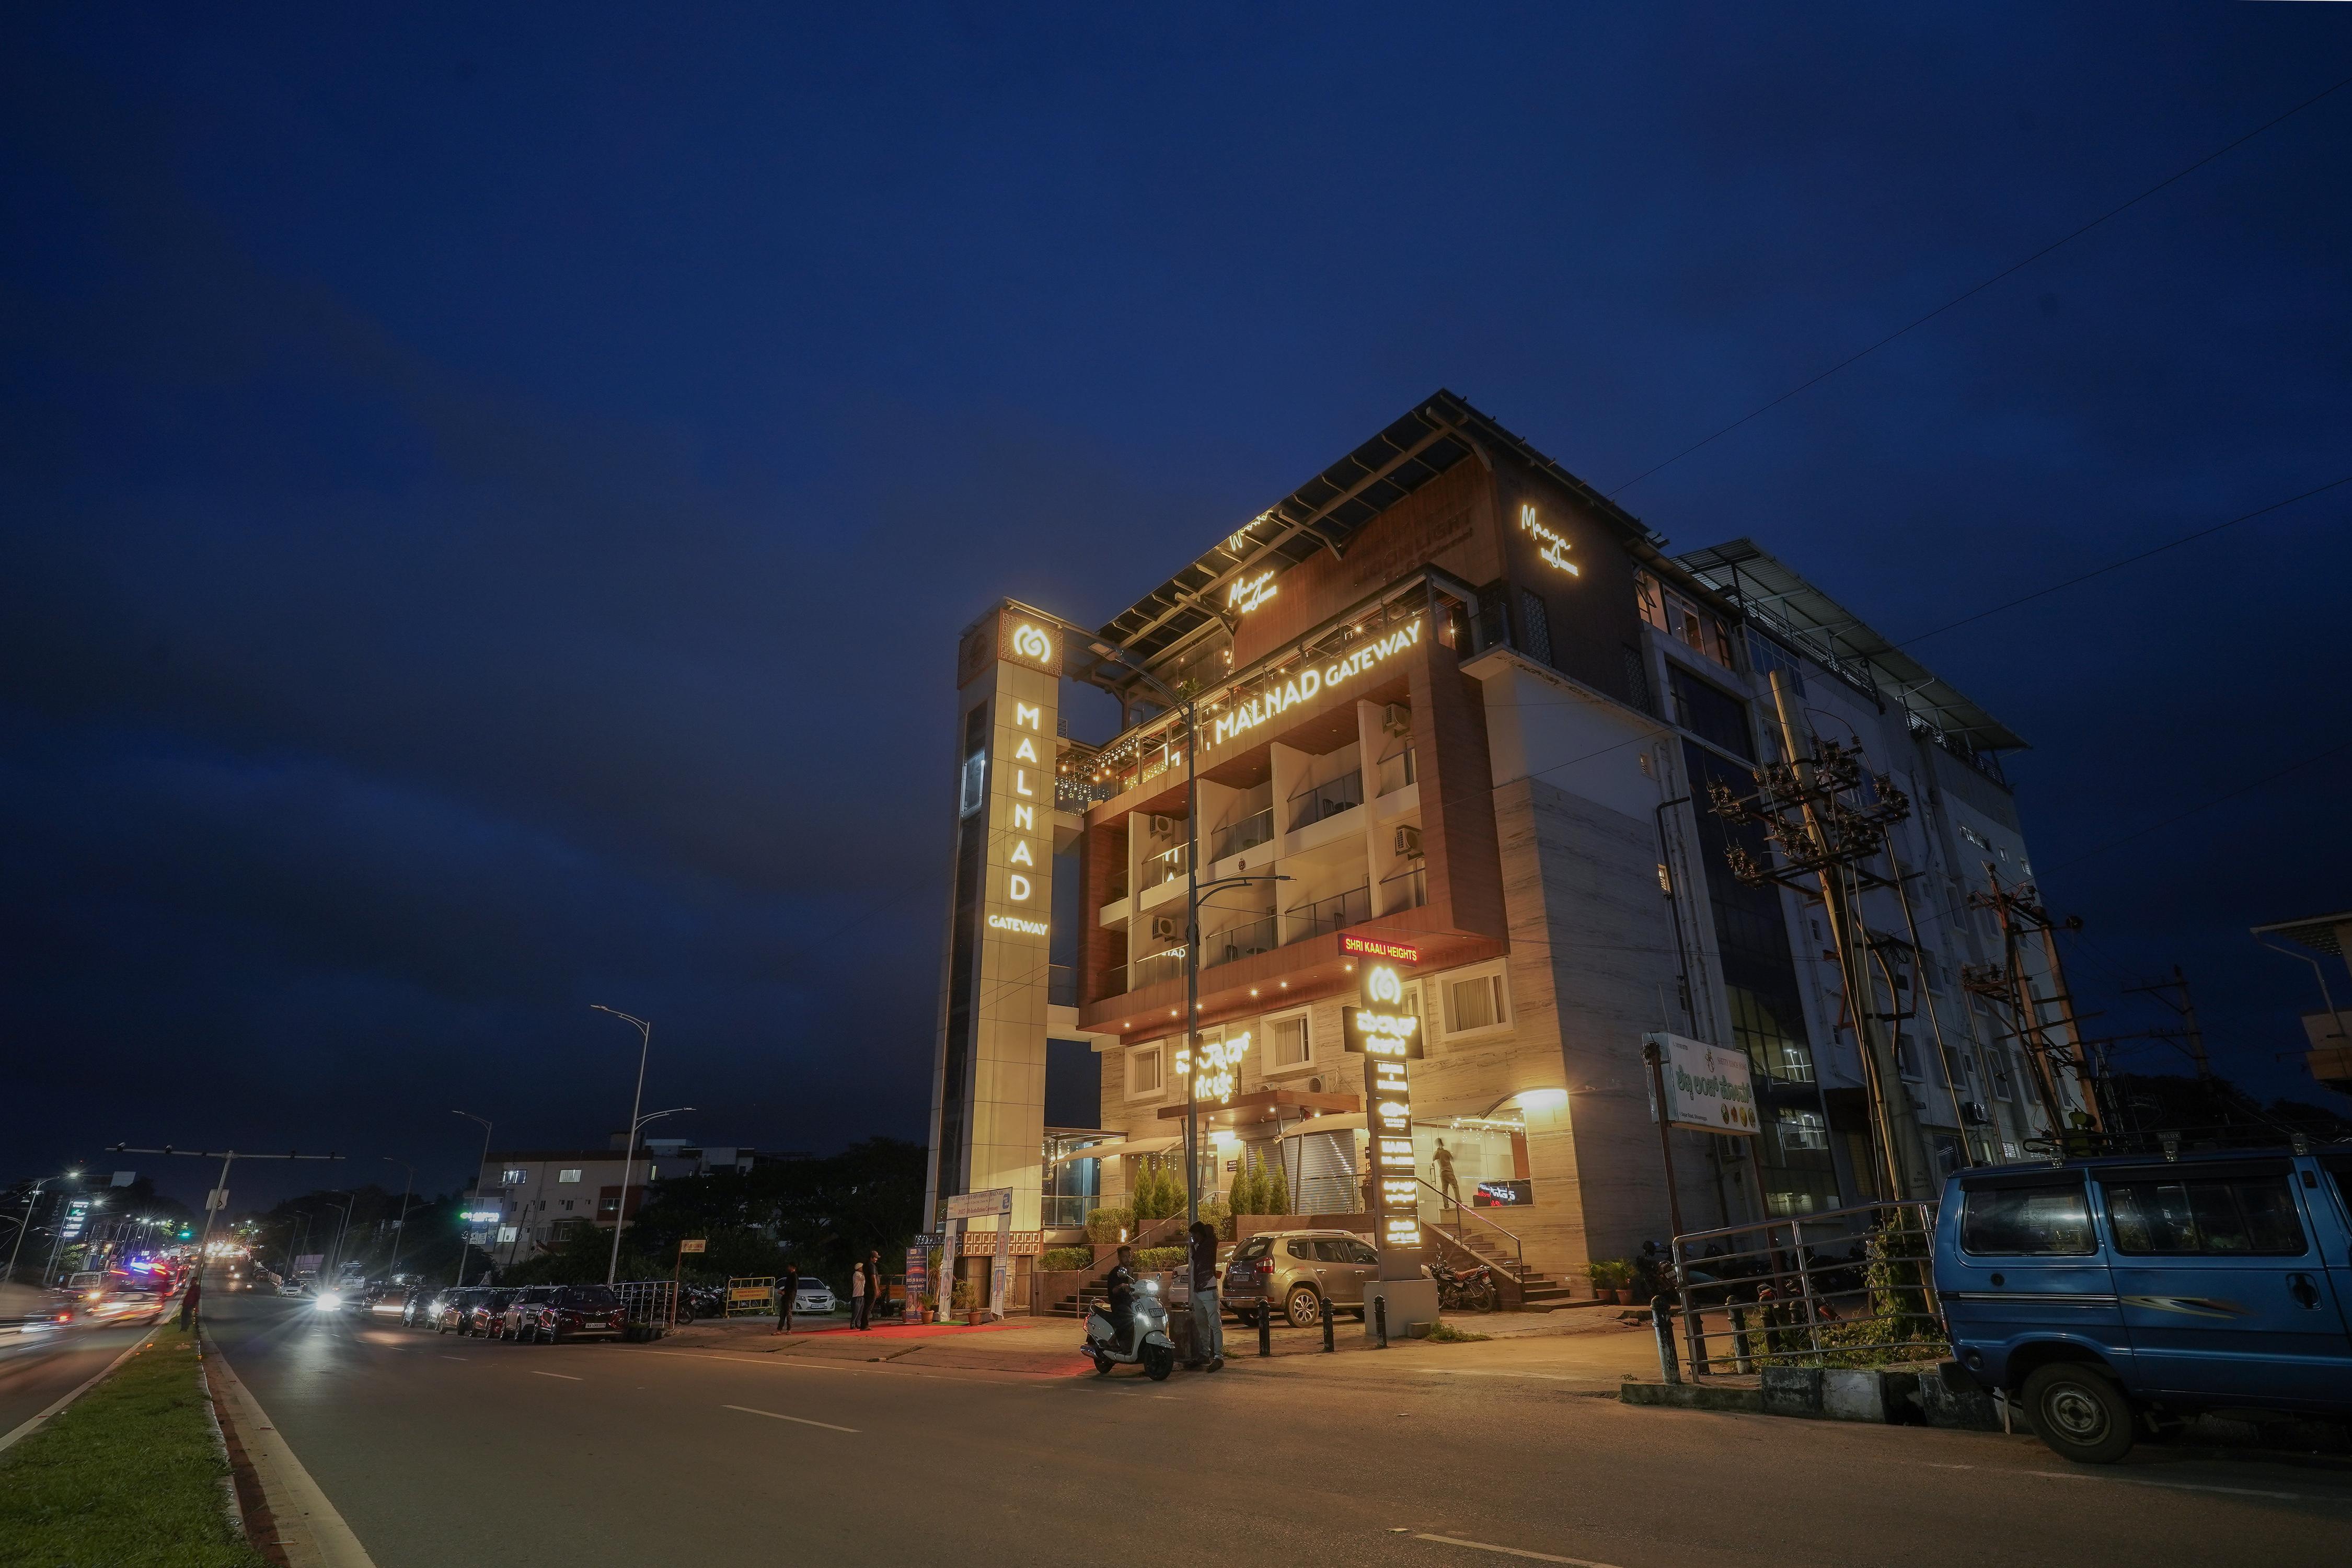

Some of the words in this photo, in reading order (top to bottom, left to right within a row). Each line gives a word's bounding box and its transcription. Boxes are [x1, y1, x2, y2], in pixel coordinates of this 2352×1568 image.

[1215, 669, 1322, 744] MALNAD
[1325, 619, 1421, 687] GATEWAY
[1009, 702, 1040, 901] MALNAD
[988, 915, 1048, 936] GATEWAY
[1346, 938, 1363, 951] SHRI
[1365, 942, 1386, 955] KAALI
[1387, 946, 1417, 961] HEIGHTS
